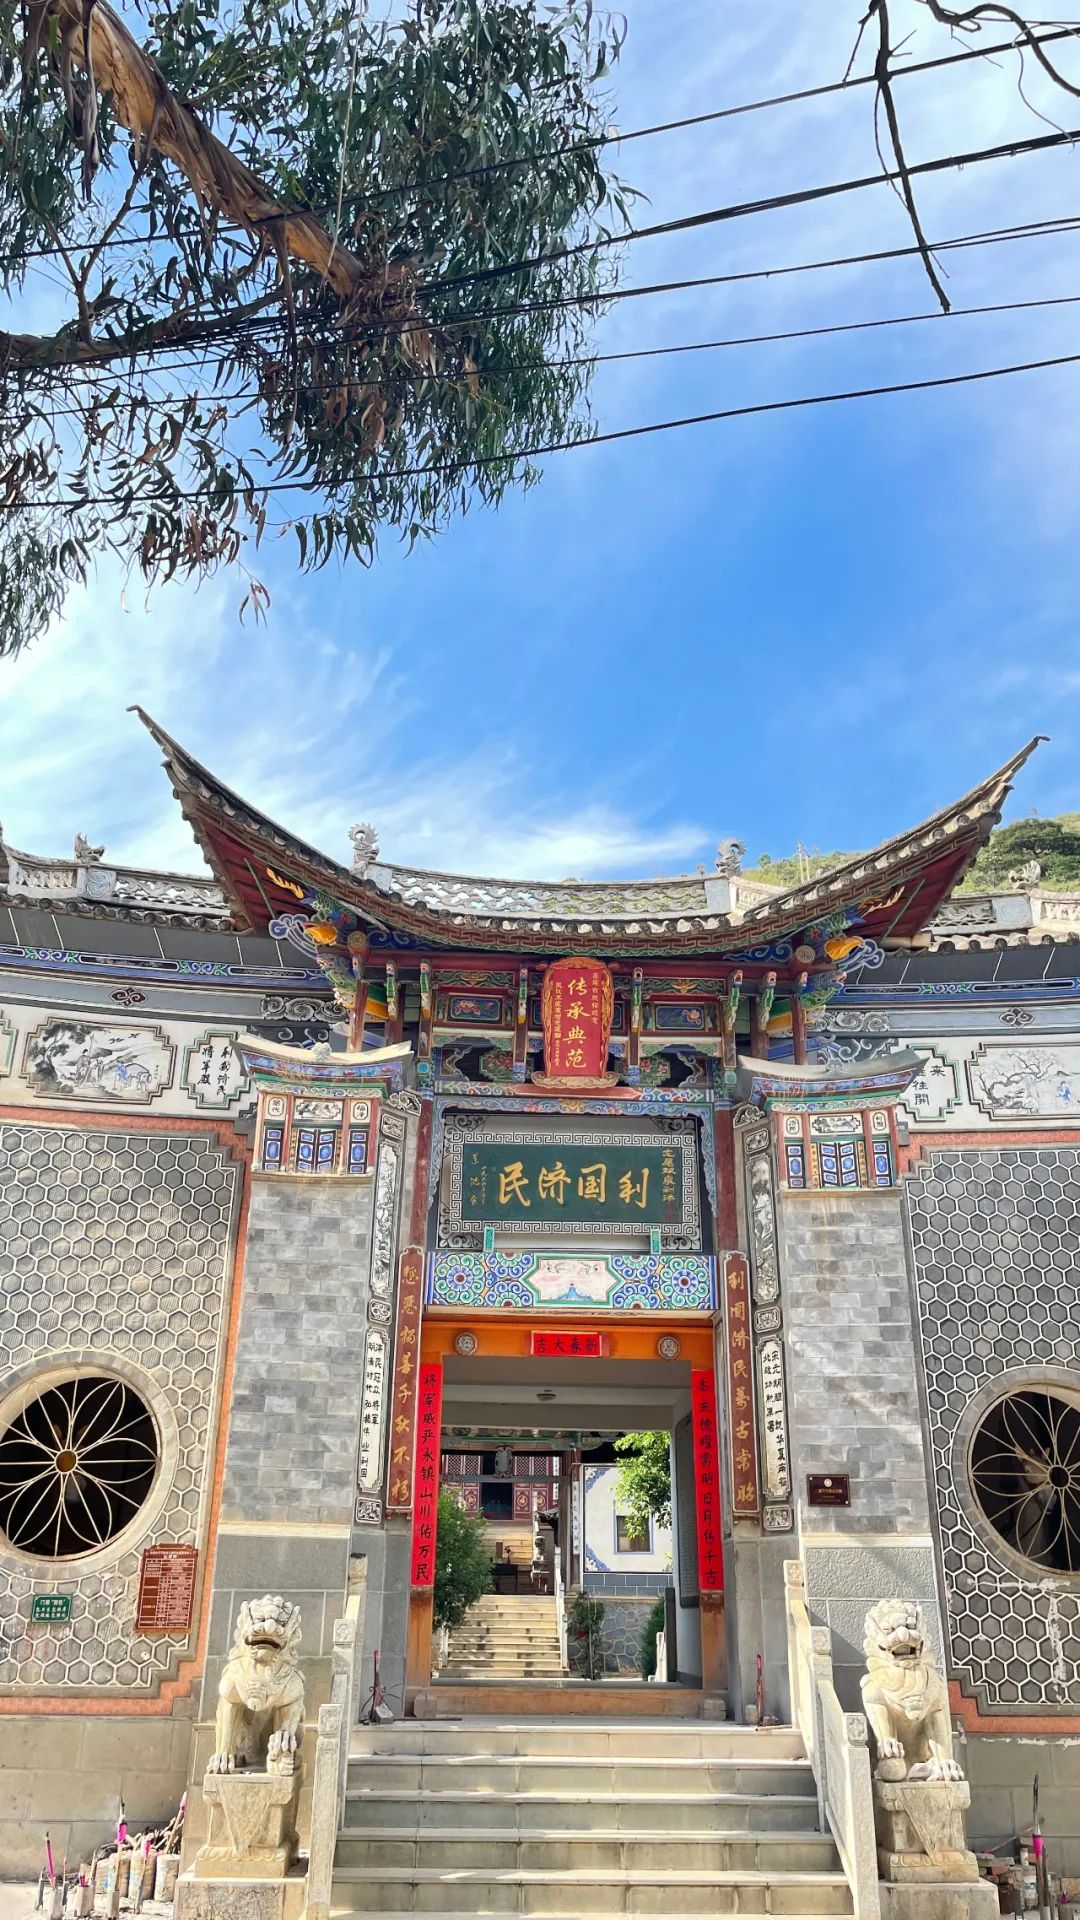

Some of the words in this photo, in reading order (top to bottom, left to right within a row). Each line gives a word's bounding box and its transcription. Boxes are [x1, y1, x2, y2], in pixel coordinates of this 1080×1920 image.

[563, 976, 591, 1068] 传承典范
[499, 1160, 650, 1209] 利国济民
